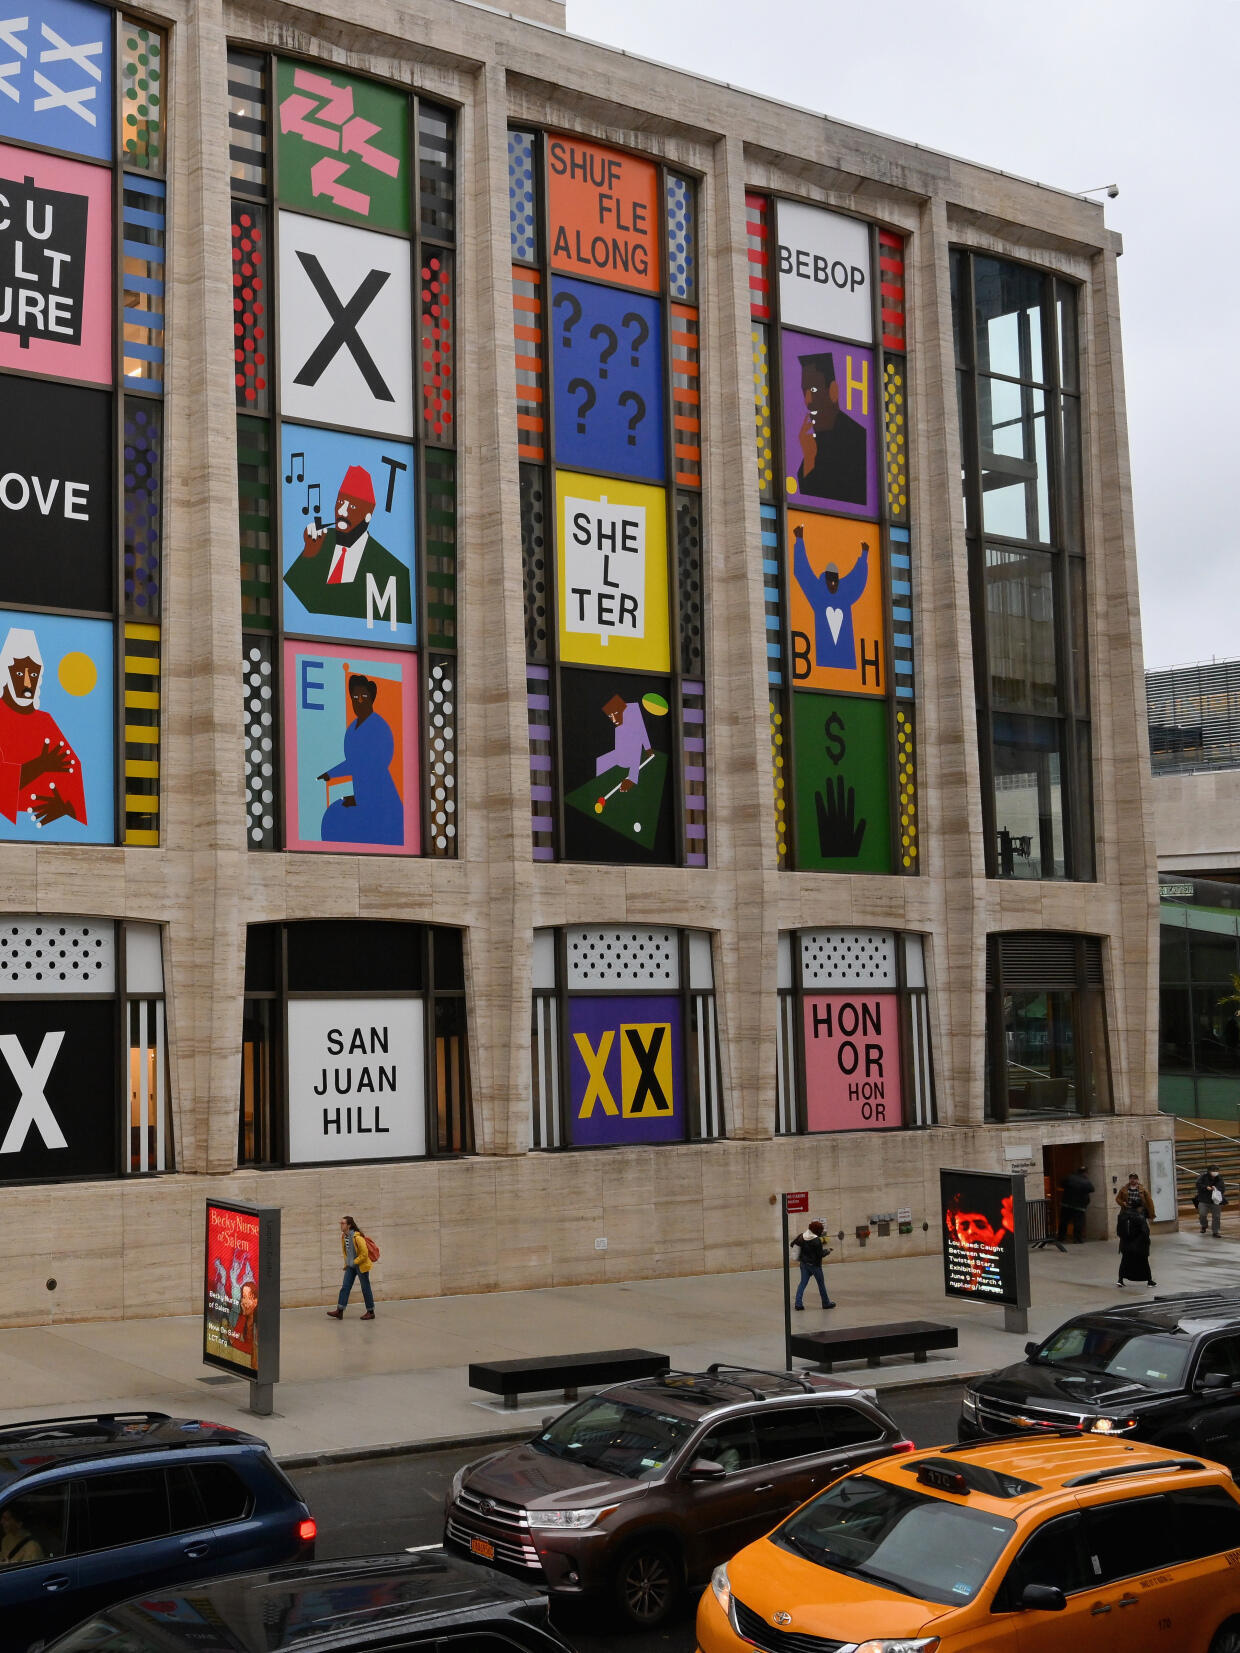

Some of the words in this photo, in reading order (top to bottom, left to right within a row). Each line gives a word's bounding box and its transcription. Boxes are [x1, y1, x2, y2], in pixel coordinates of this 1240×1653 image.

[551, 143, 622, 190] SHUF
[599, 193, 648, 236] FLE
[14, 239, 71, 288] LT
[554, 225, 648, 277] ALONG
[778, 245, 866, 294] BEBOP
[293, 250, 395, 403] X
[846, 355, 868, 416] H
[381, 455, 408, 514] T
[573, 512, 639, 554] SHE
[603, 554, 620, 589] L
[365, 572, 397, 632] M
[571, 587, 639, 629] TER
[792, 630, 811, 680] B
[860, 637, 880, 688] H
[302, 660, 324, 711] E
[812, 1000, 882, 1039] HON
[326, 1026, 389, 1056] SAN
[837, 1040, 884, 1079] OR
[313, 1065, 397, 1096] JUAN
[848, 1081, 886, 1101] HON
[322, 1105, 390, 1135] HILL
[861, 1102, 887, 1122] OR
[211, 1209, 237, 1232] Becky
[236, 1216, 259, 1236] Nurse
[225, 1231, 249, 1251] Salem
[948, 1248, 978, 1257] Between
[948, 1256, 975, 1265] Twisted
[976, 1259, 995, 1268] Stars
[980, 1244, 1004, 1253] Caught
[949, 1264, 981, 1274] Exhibition
[977, 1276, 997, 1285] March
[215, 1303, 230, 1313] Salem
